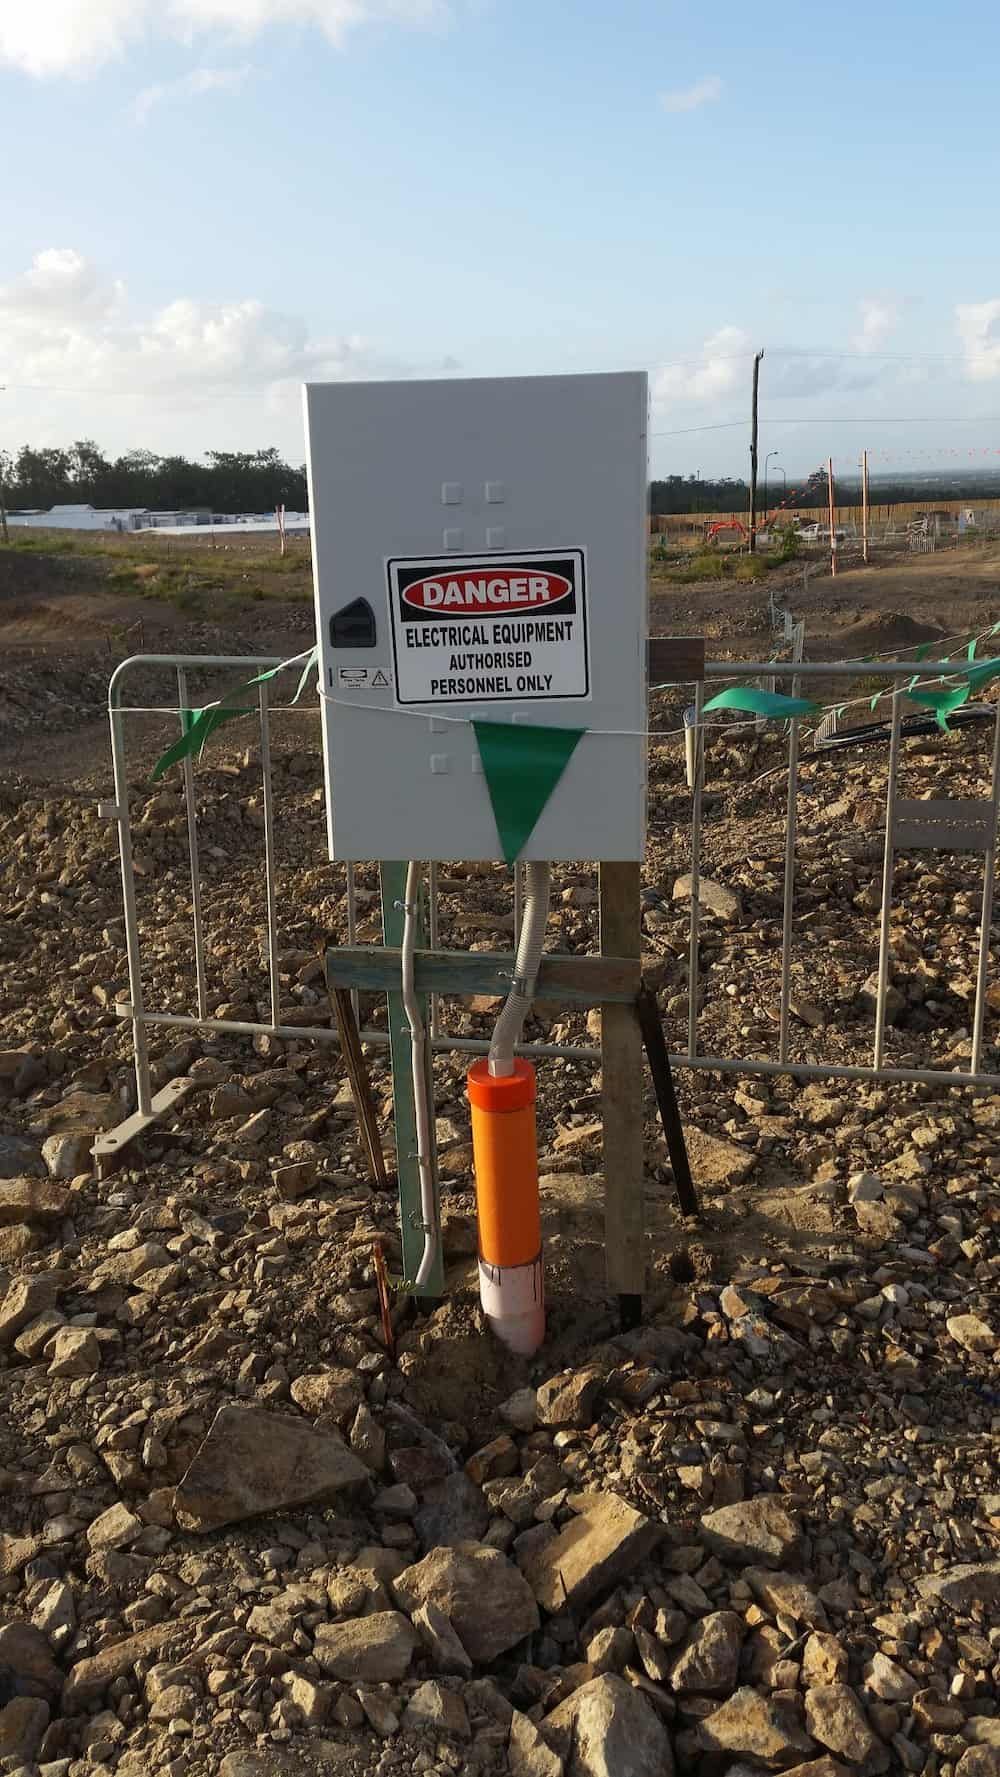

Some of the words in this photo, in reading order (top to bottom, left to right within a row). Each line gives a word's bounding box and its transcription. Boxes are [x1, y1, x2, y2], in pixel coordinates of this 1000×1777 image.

[422, 577, 550, 606] DANGER
[406, 624, 489, 648] ELECTRICAL
[493, 621, 573, 645] EQUIPMENT
[449, 651, 532, 670] AUTHORISED
[431, 676, 513, 695] PERSONNEL
[516, 674, 553, 691] ONLY
